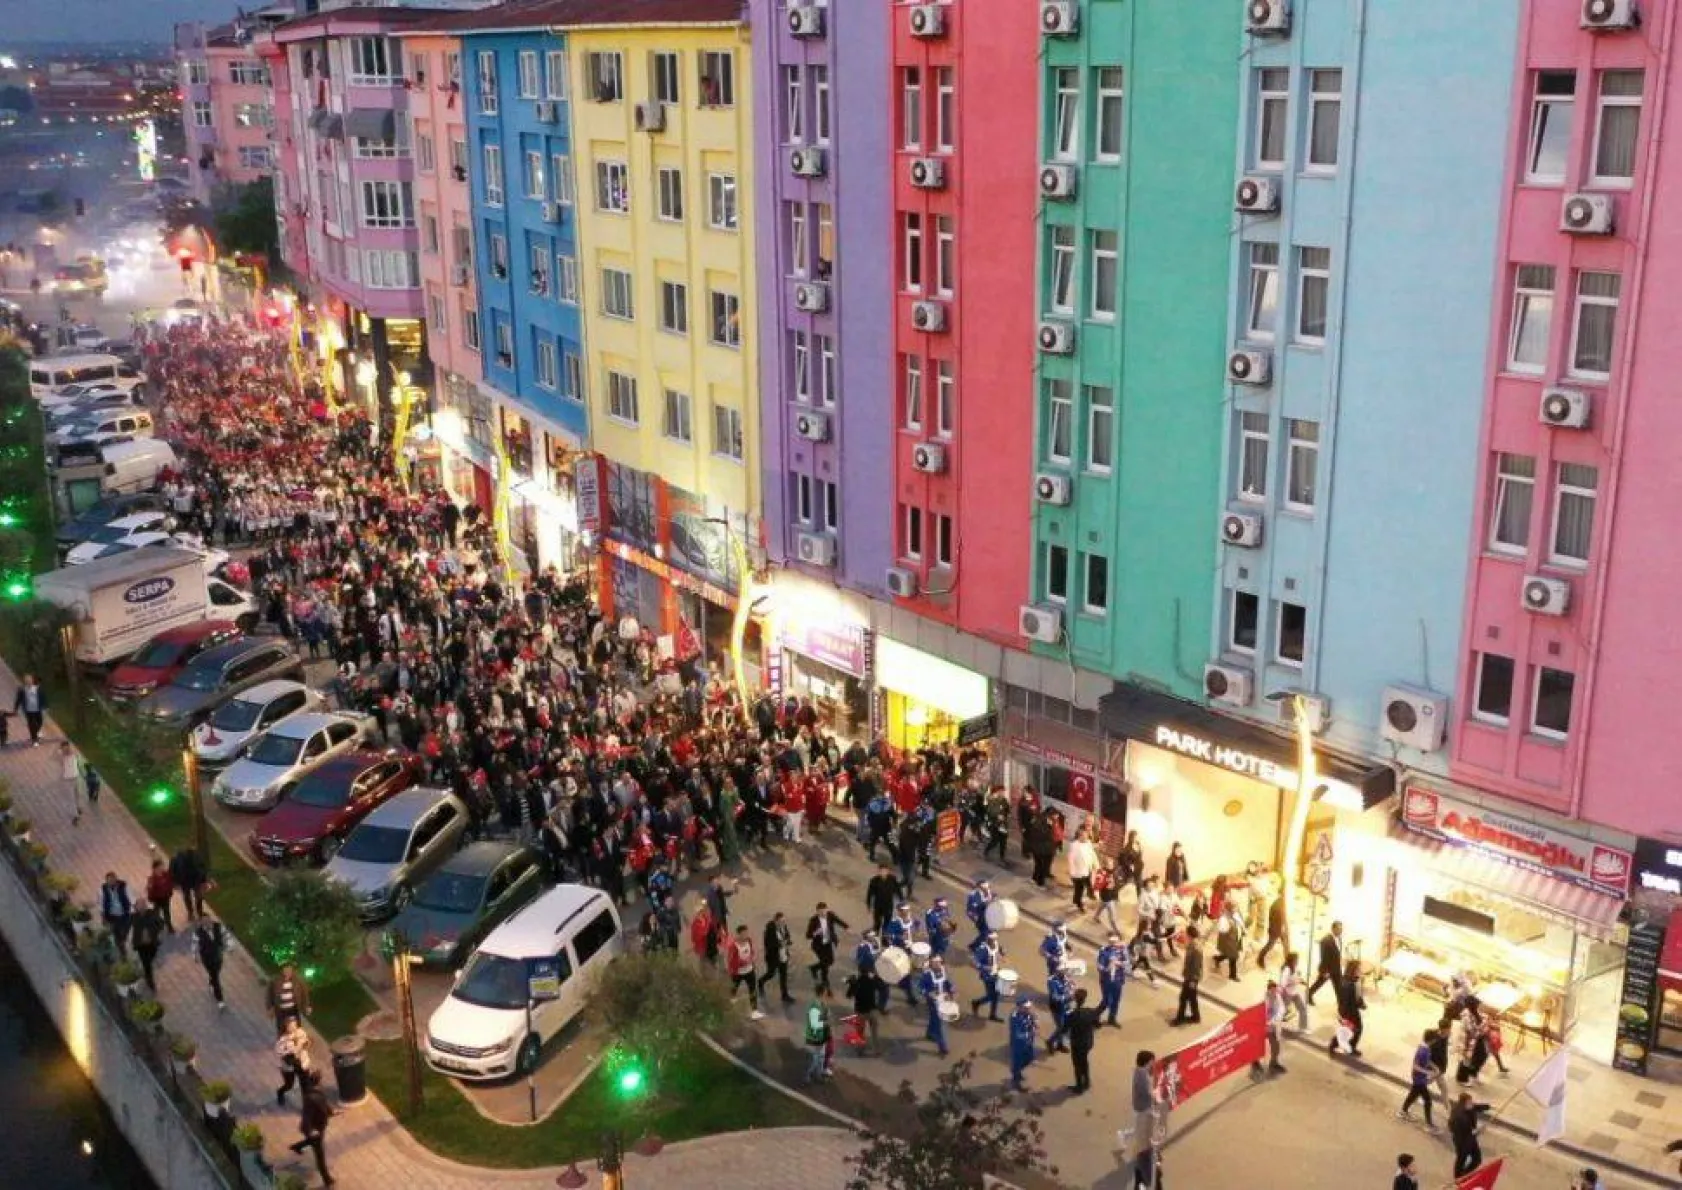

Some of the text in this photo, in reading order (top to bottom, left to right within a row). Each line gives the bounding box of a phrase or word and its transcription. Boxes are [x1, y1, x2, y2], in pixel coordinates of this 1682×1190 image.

[128, 580, 169, 600] SERPA
[1157, 726, 1289, 783] PARK HOTE
